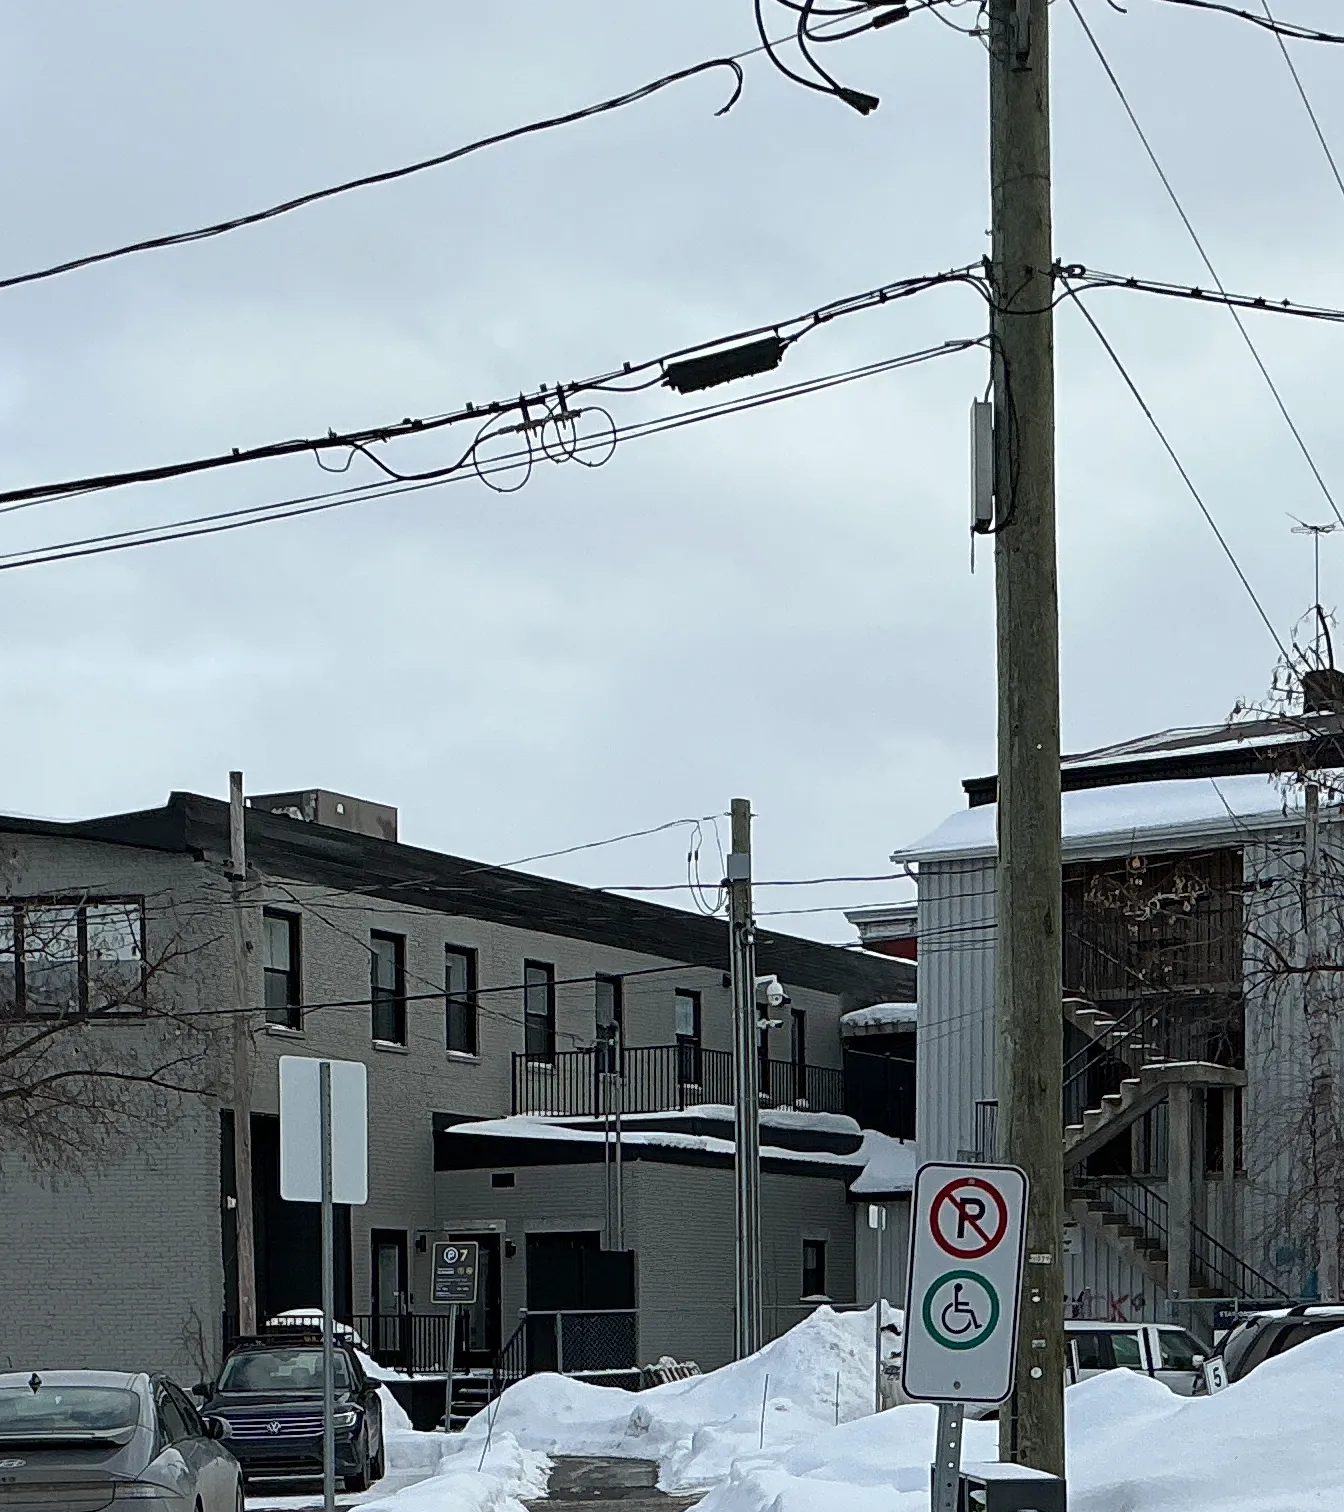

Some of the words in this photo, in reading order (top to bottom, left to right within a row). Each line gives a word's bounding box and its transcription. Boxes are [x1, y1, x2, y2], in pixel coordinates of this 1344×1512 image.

[957, 1197, 986, 1239] P
[459, 1249, 468, 1262] 7
[1212, 1366, 1223, 1388] 5
